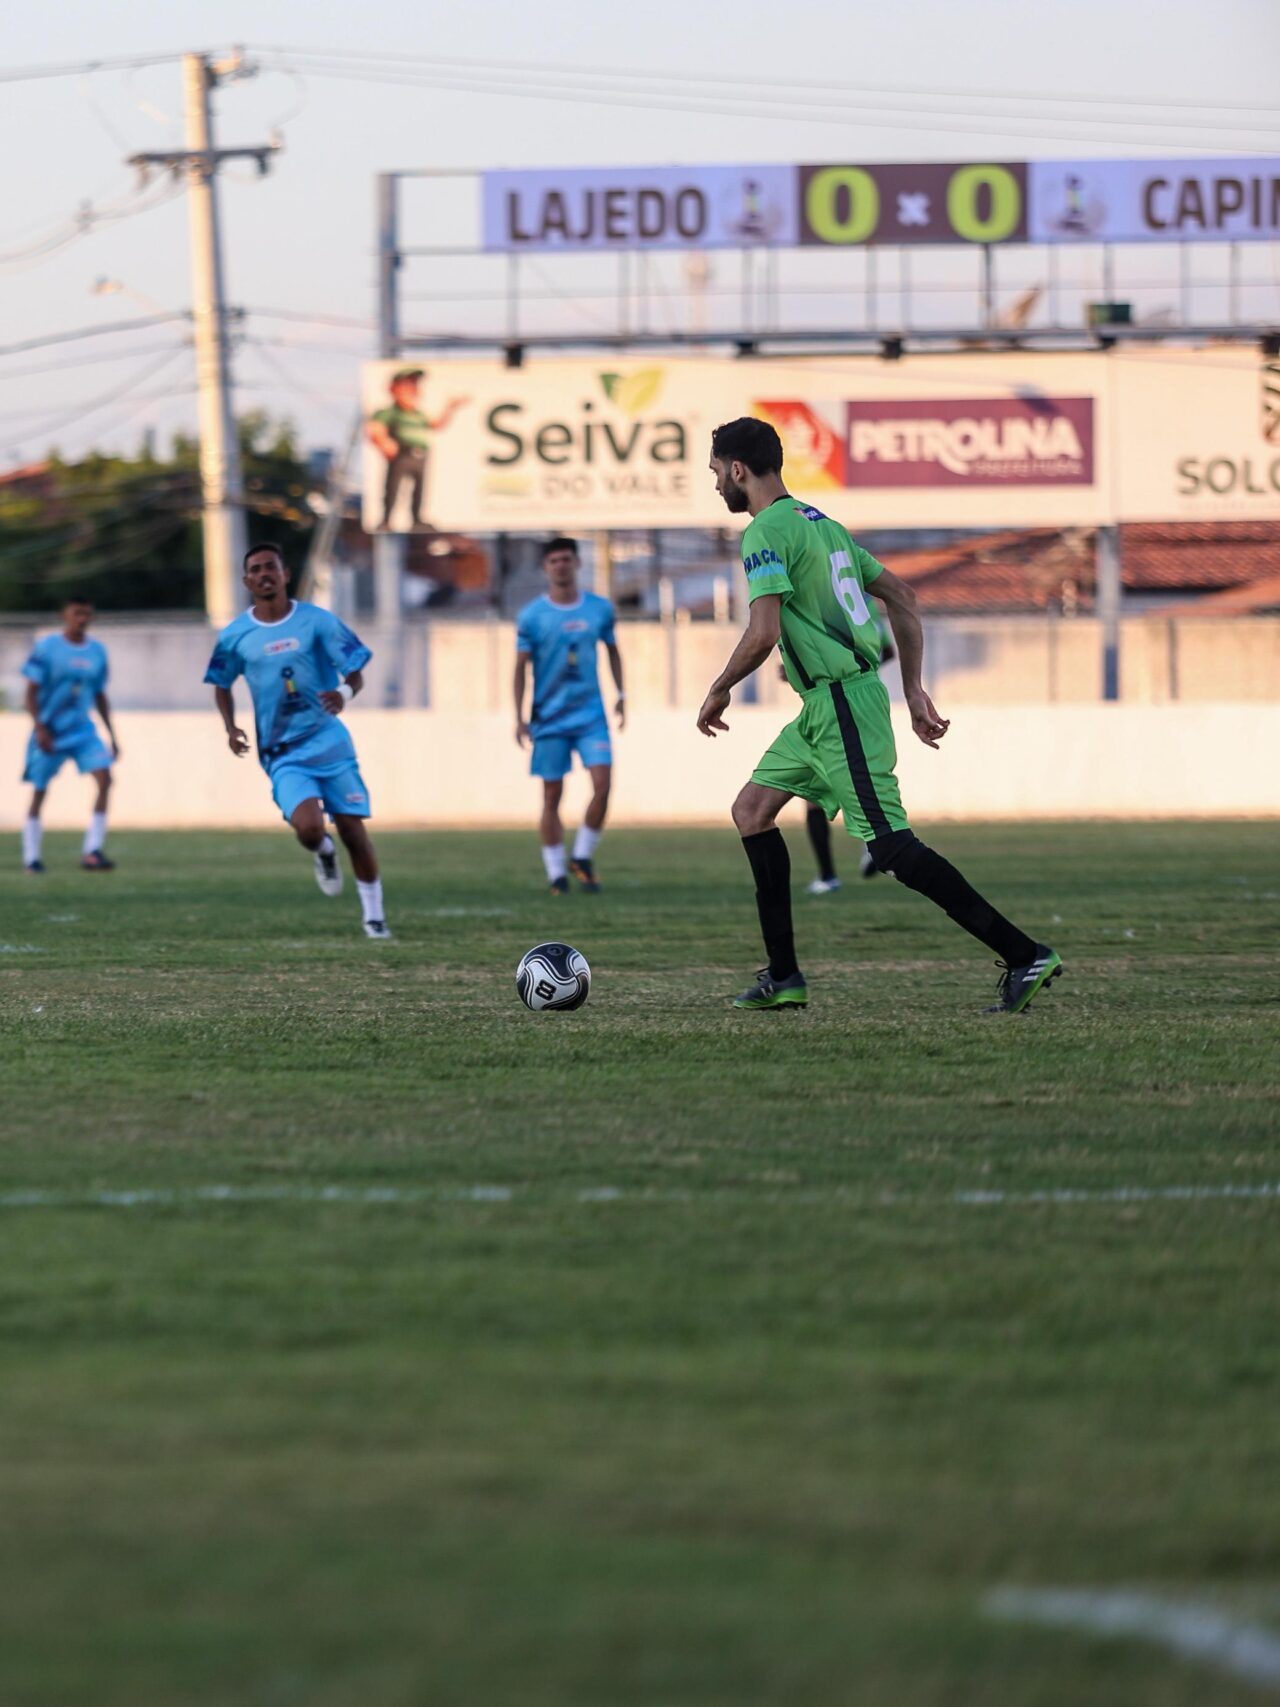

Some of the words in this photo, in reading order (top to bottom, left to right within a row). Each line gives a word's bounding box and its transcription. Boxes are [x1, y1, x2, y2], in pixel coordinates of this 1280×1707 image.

[508, 187, 707, 241] LAJEDO
[806, 165, 878, 245] 0
[946, 163, 1021, 243] 0
[486, 401, 687, 465] Seiva
[850, 416, 1084, 476] PETROLINA
[544, 473, 593, 498] DO
[604, 473, 689, 497] VALE
[829, 550, 871, 626] 6
